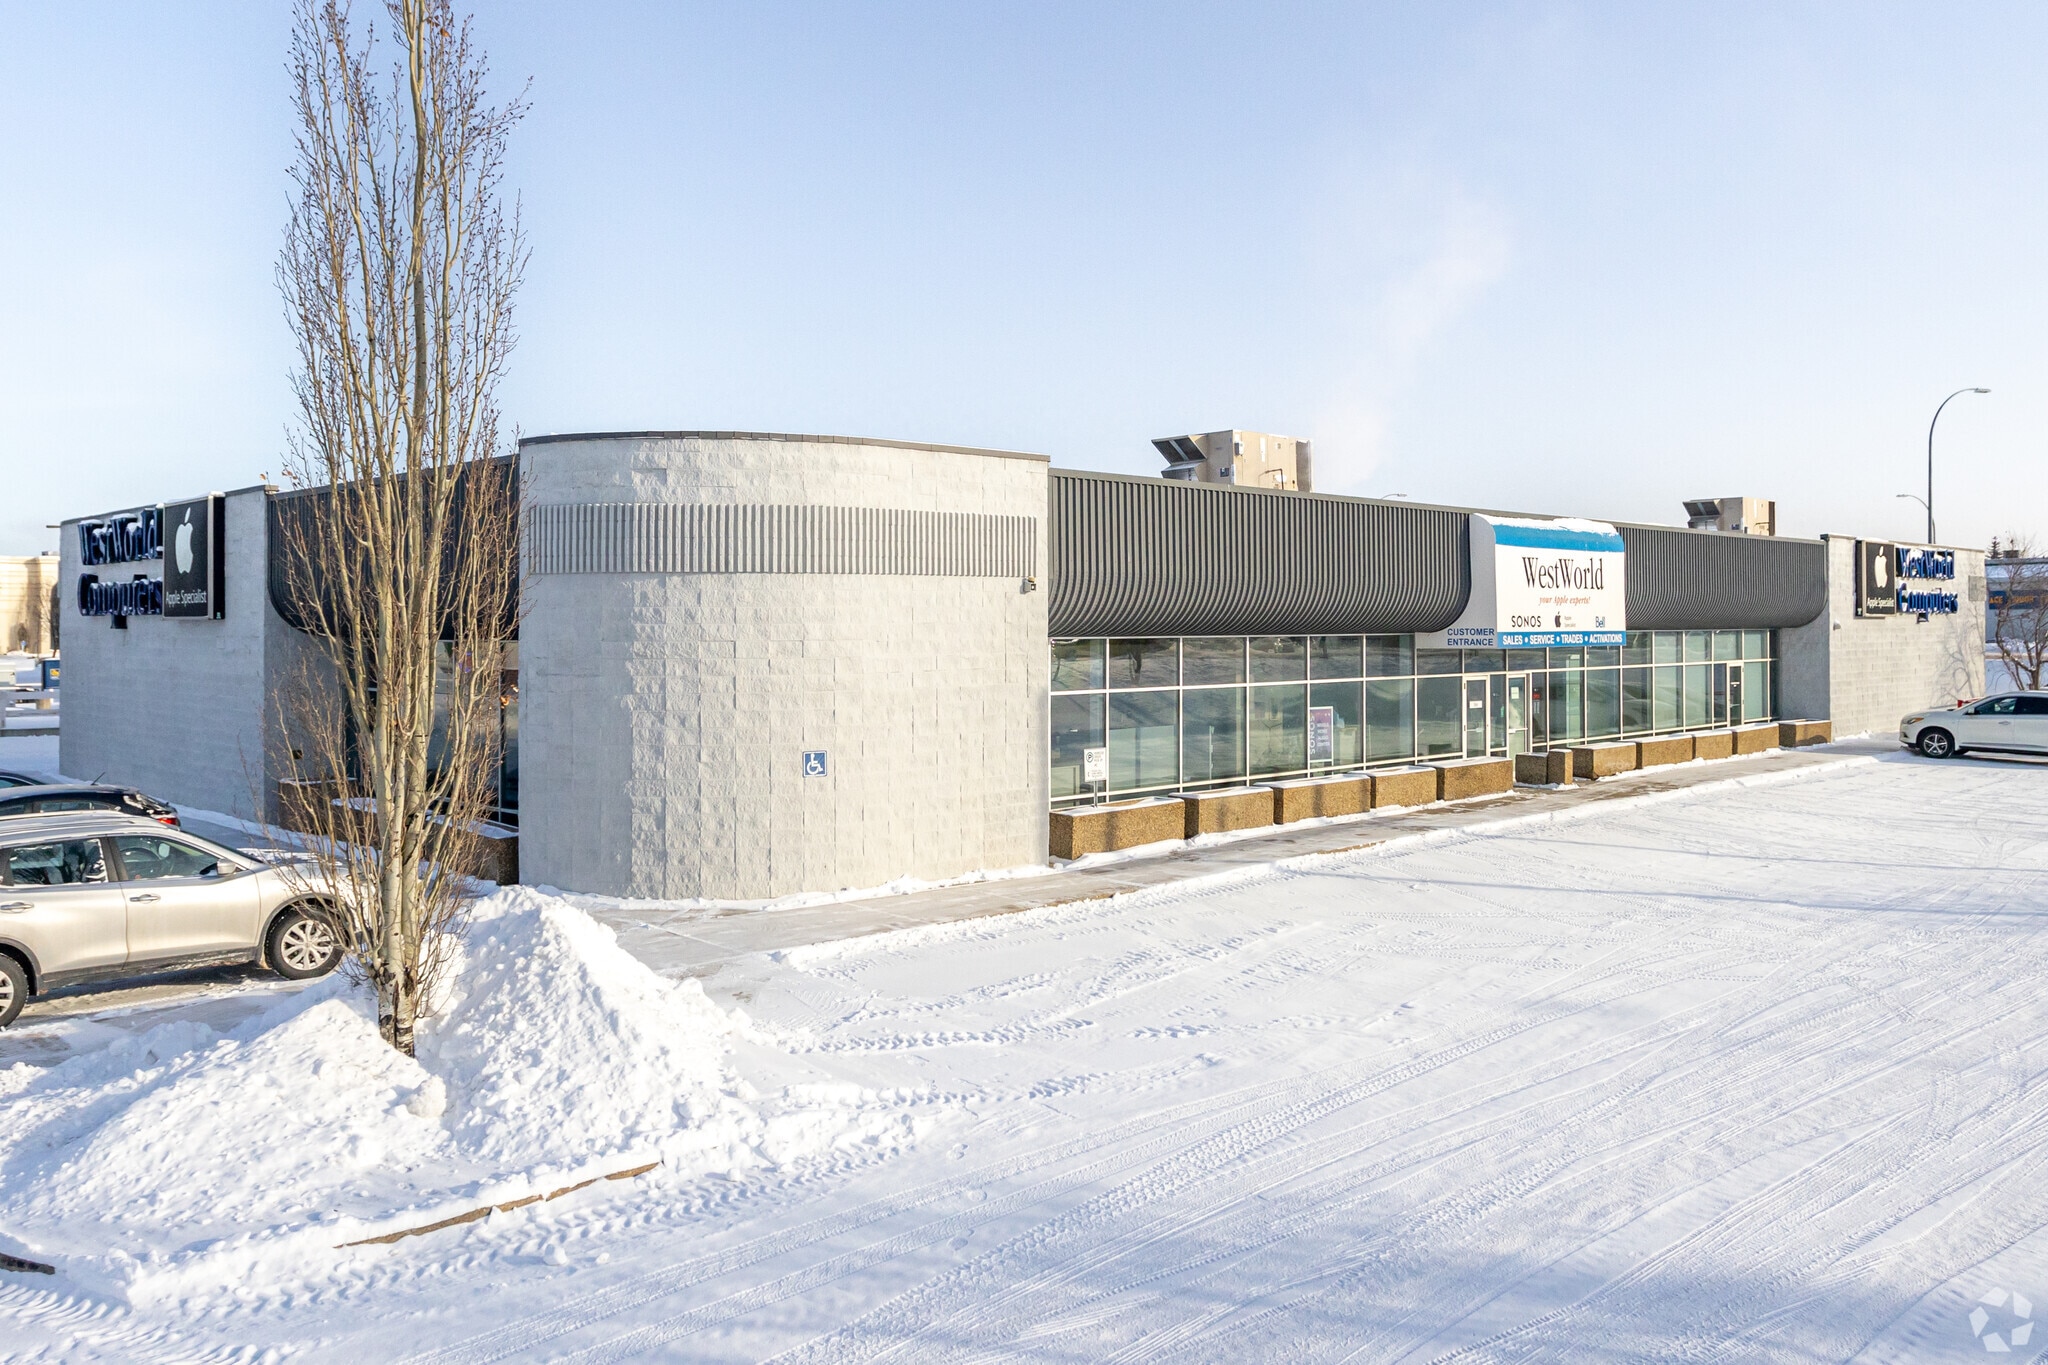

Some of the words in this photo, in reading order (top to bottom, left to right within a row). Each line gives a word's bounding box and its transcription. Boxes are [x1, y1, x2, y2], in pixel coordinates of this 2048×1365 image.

[78, 508, 163, 565] WestWorld
[1899, 547, 1955, 579] WestWorld
[1522, 557, 1604, 590] WestWorld
[78, 573, 163, 616] Computers
[166, 590, 180, 607] Apple
[181, 589, 207, 607] Specialist
[1539, 597, 1552, 606] your
[1511, 615, 1542, 628] SONOS
[1595, 616, 1605, 628] Bell
[1447, 628, 1495, 636] CUSTOMER
[1447, 638, 1494, 646] ENTRANCE
[1503, 635, 1523, 645] SALES
[1530, 635, 1555, 645] SERVICE
[1561, 634, 1583, 644] TRADES
[1589, 633, 1623, 643] ACTIVATIONS
